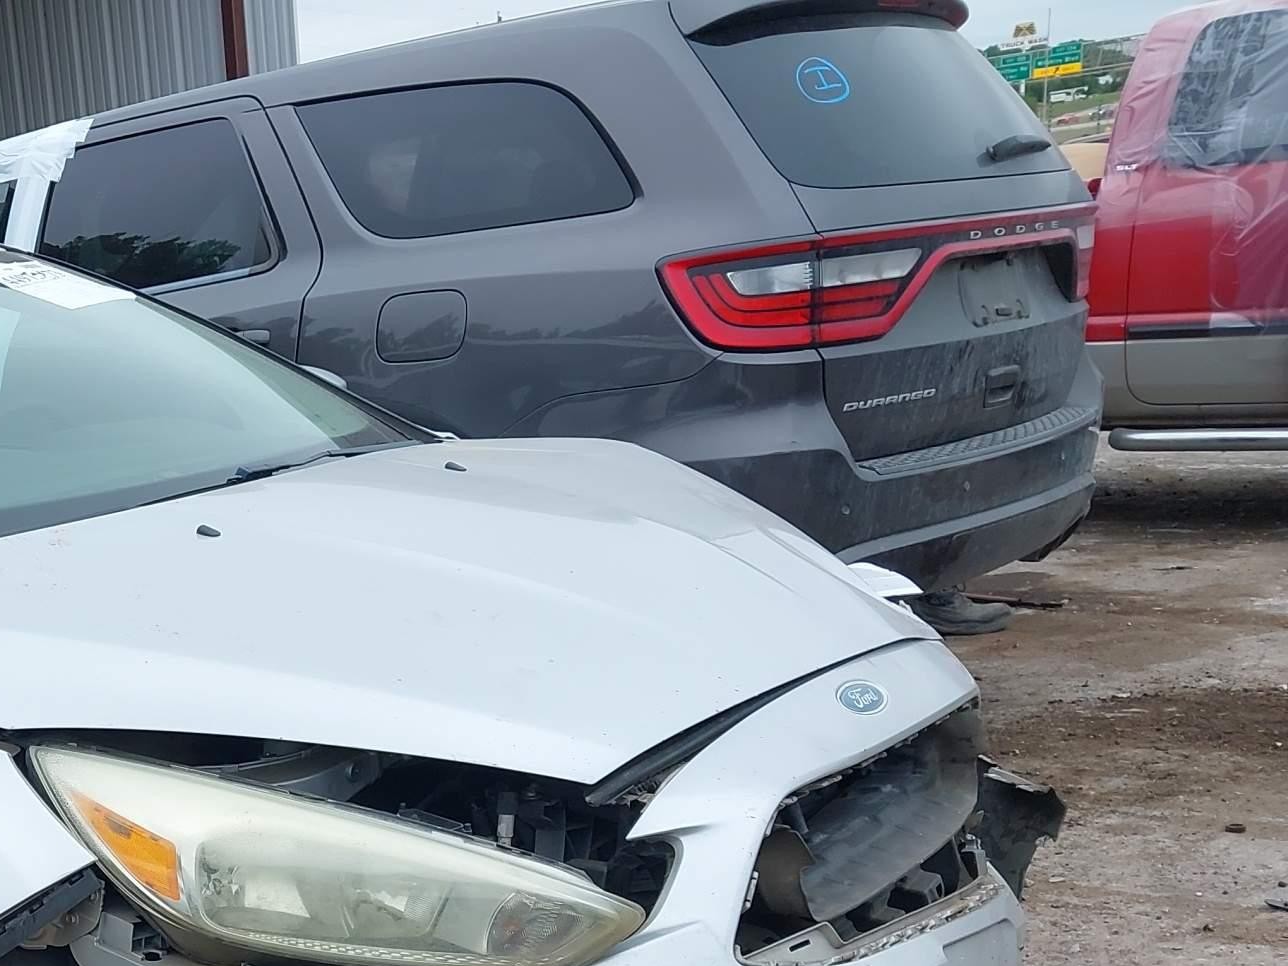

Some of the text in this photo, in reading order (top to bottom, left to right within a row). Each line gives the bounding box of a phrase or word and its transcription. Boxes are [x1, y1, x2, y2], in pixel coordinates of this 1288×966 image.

[969, 220, 1060, 240] DODGE
[842, 388, 937, 412] DURANGO
[847, 687, 879, 709] Ford
